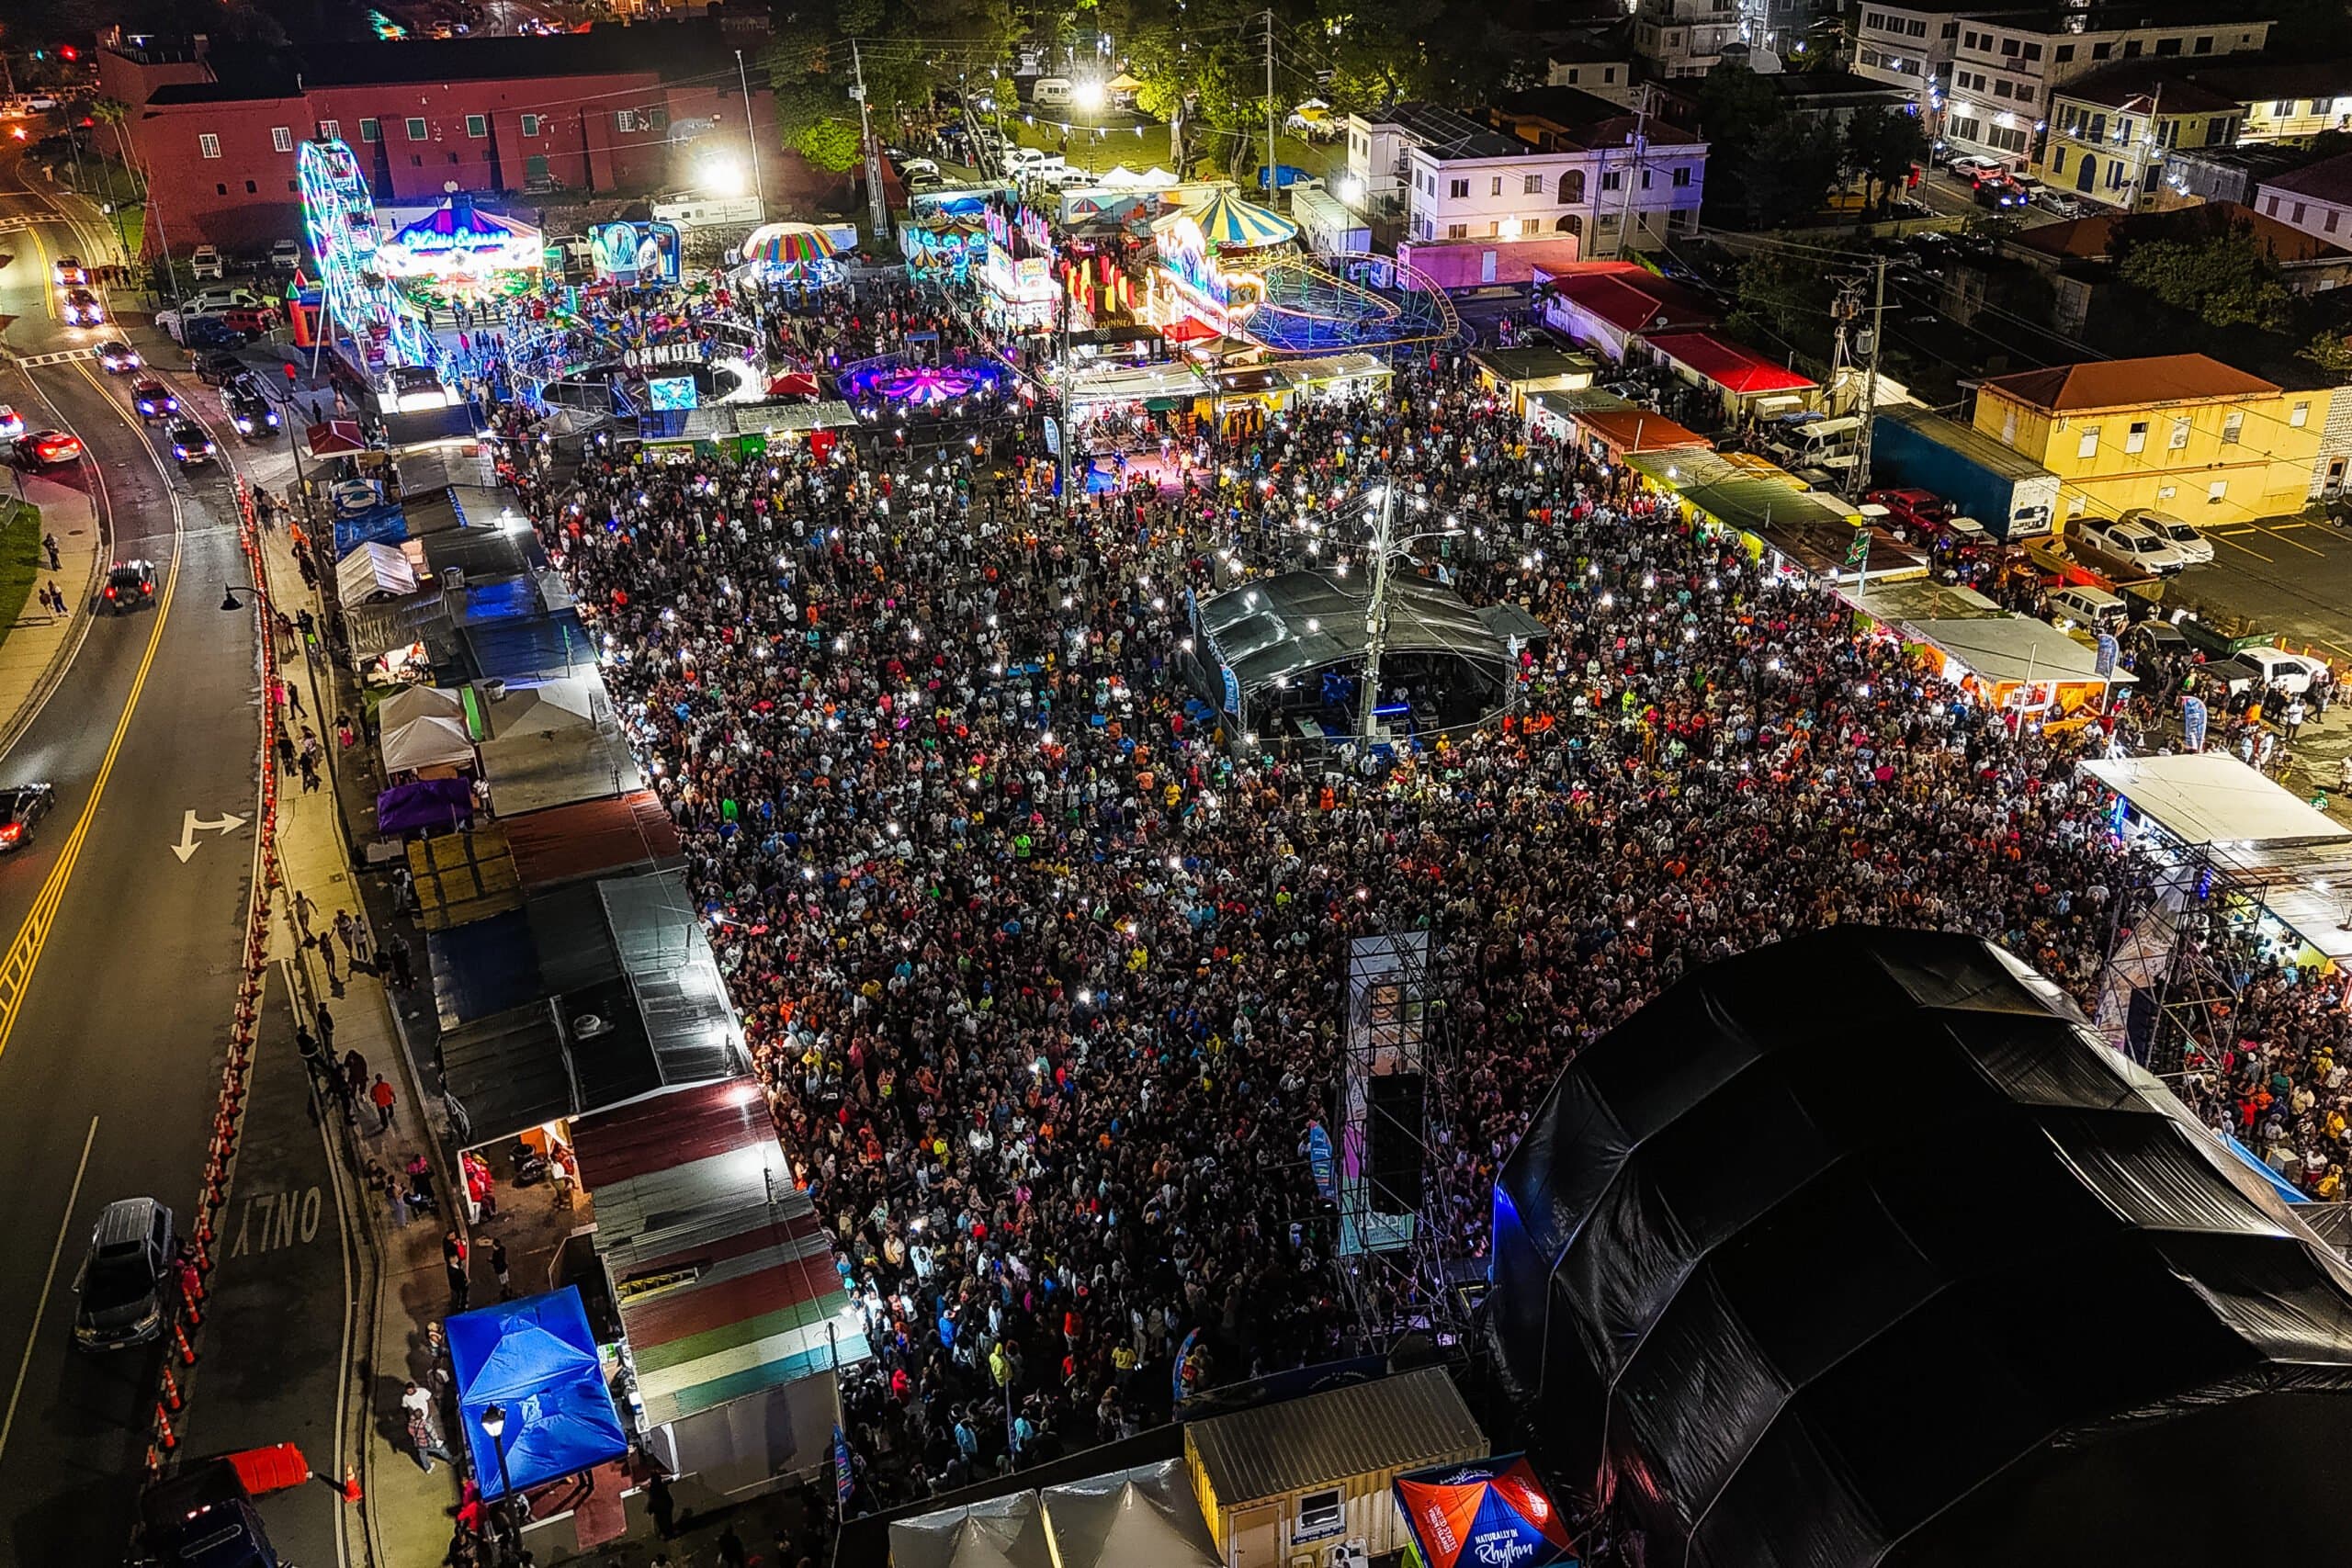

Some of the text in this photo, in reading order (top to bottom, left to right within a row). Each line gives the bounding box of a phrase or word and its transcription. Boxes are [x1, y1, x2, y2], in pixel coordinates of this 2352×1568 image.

[230, 1185, 322, 1259] ONLY
[1428, 1507, 1441, 1528] VIRGIN
[1433, 1504, 1448, 1528] UNITED
[1443, 1526, 1458, 1551] STATES
[1434, 1526, 1453, 1554] ISLANDS
[1475, 1528, 1519, 1544] NATURALLY IN
[1475, 1539, 1533, 1568] Rhythm
